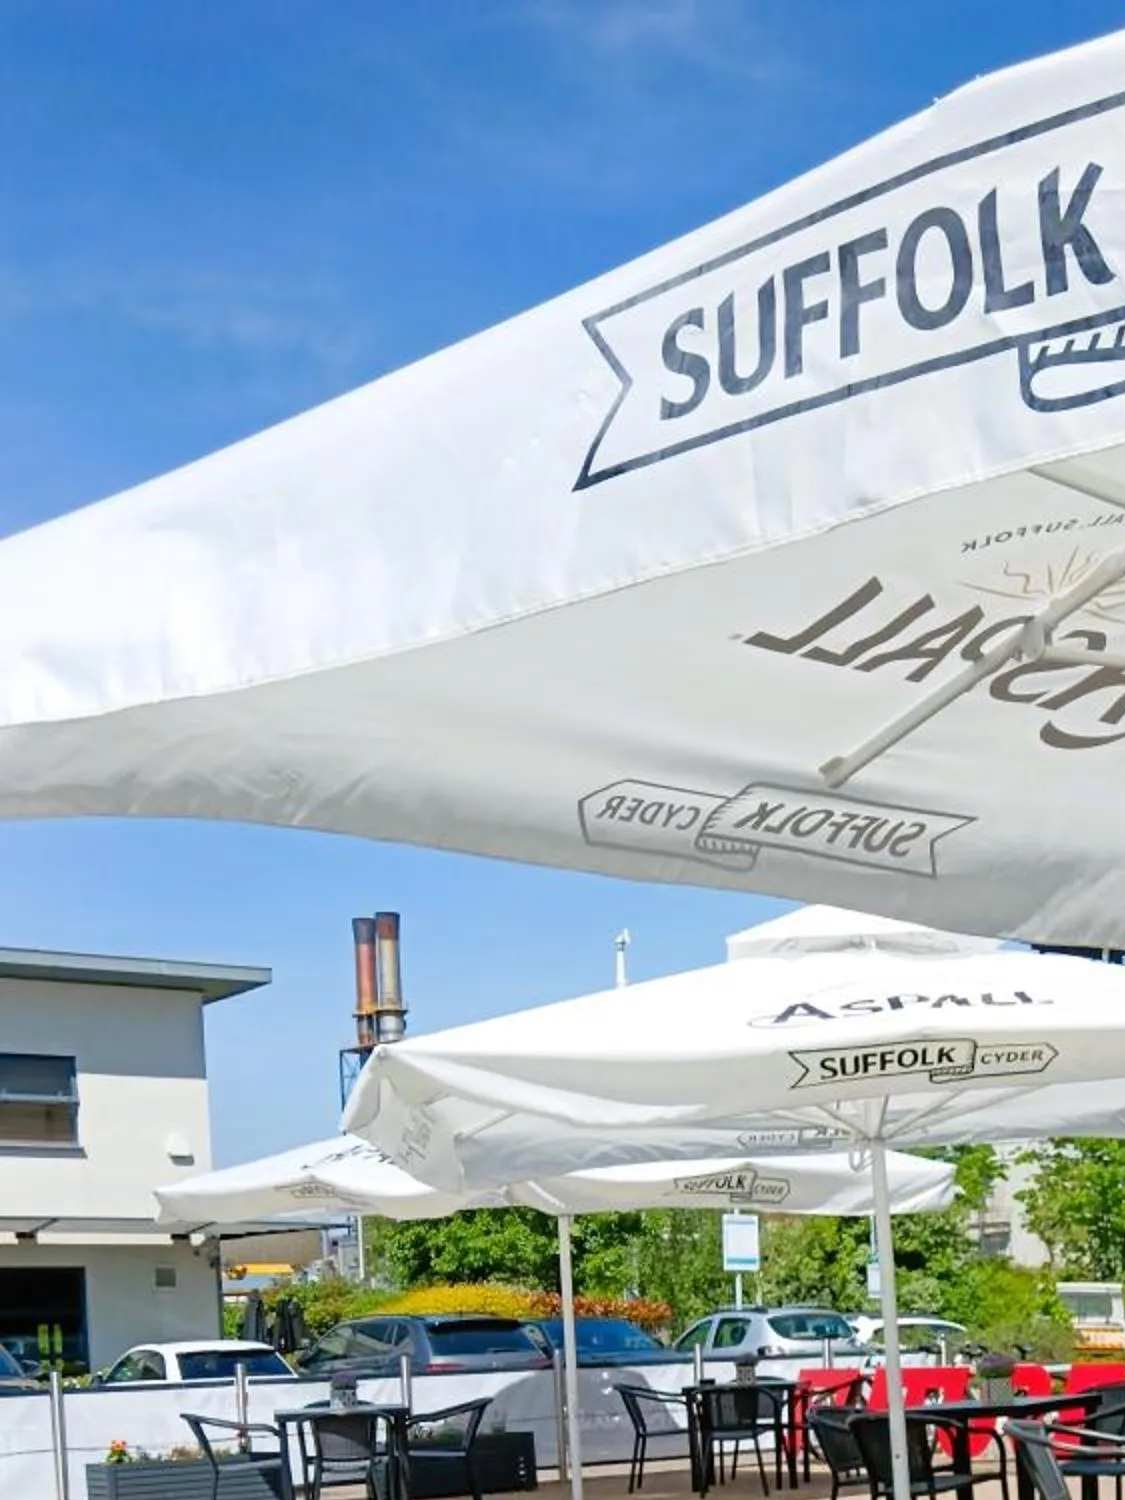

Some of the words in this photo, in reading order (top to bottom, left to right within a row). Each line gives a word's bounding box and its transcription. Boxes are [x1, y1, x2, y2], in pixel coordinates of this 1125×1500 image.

[657, 160, 1116, 422] SUFFOLK
[748, 991, 1054, 1028] ASPALL
[819, 1046, 956, 1081] SUFFOLK
[980, 1049, 1044, 1066] CYDER
